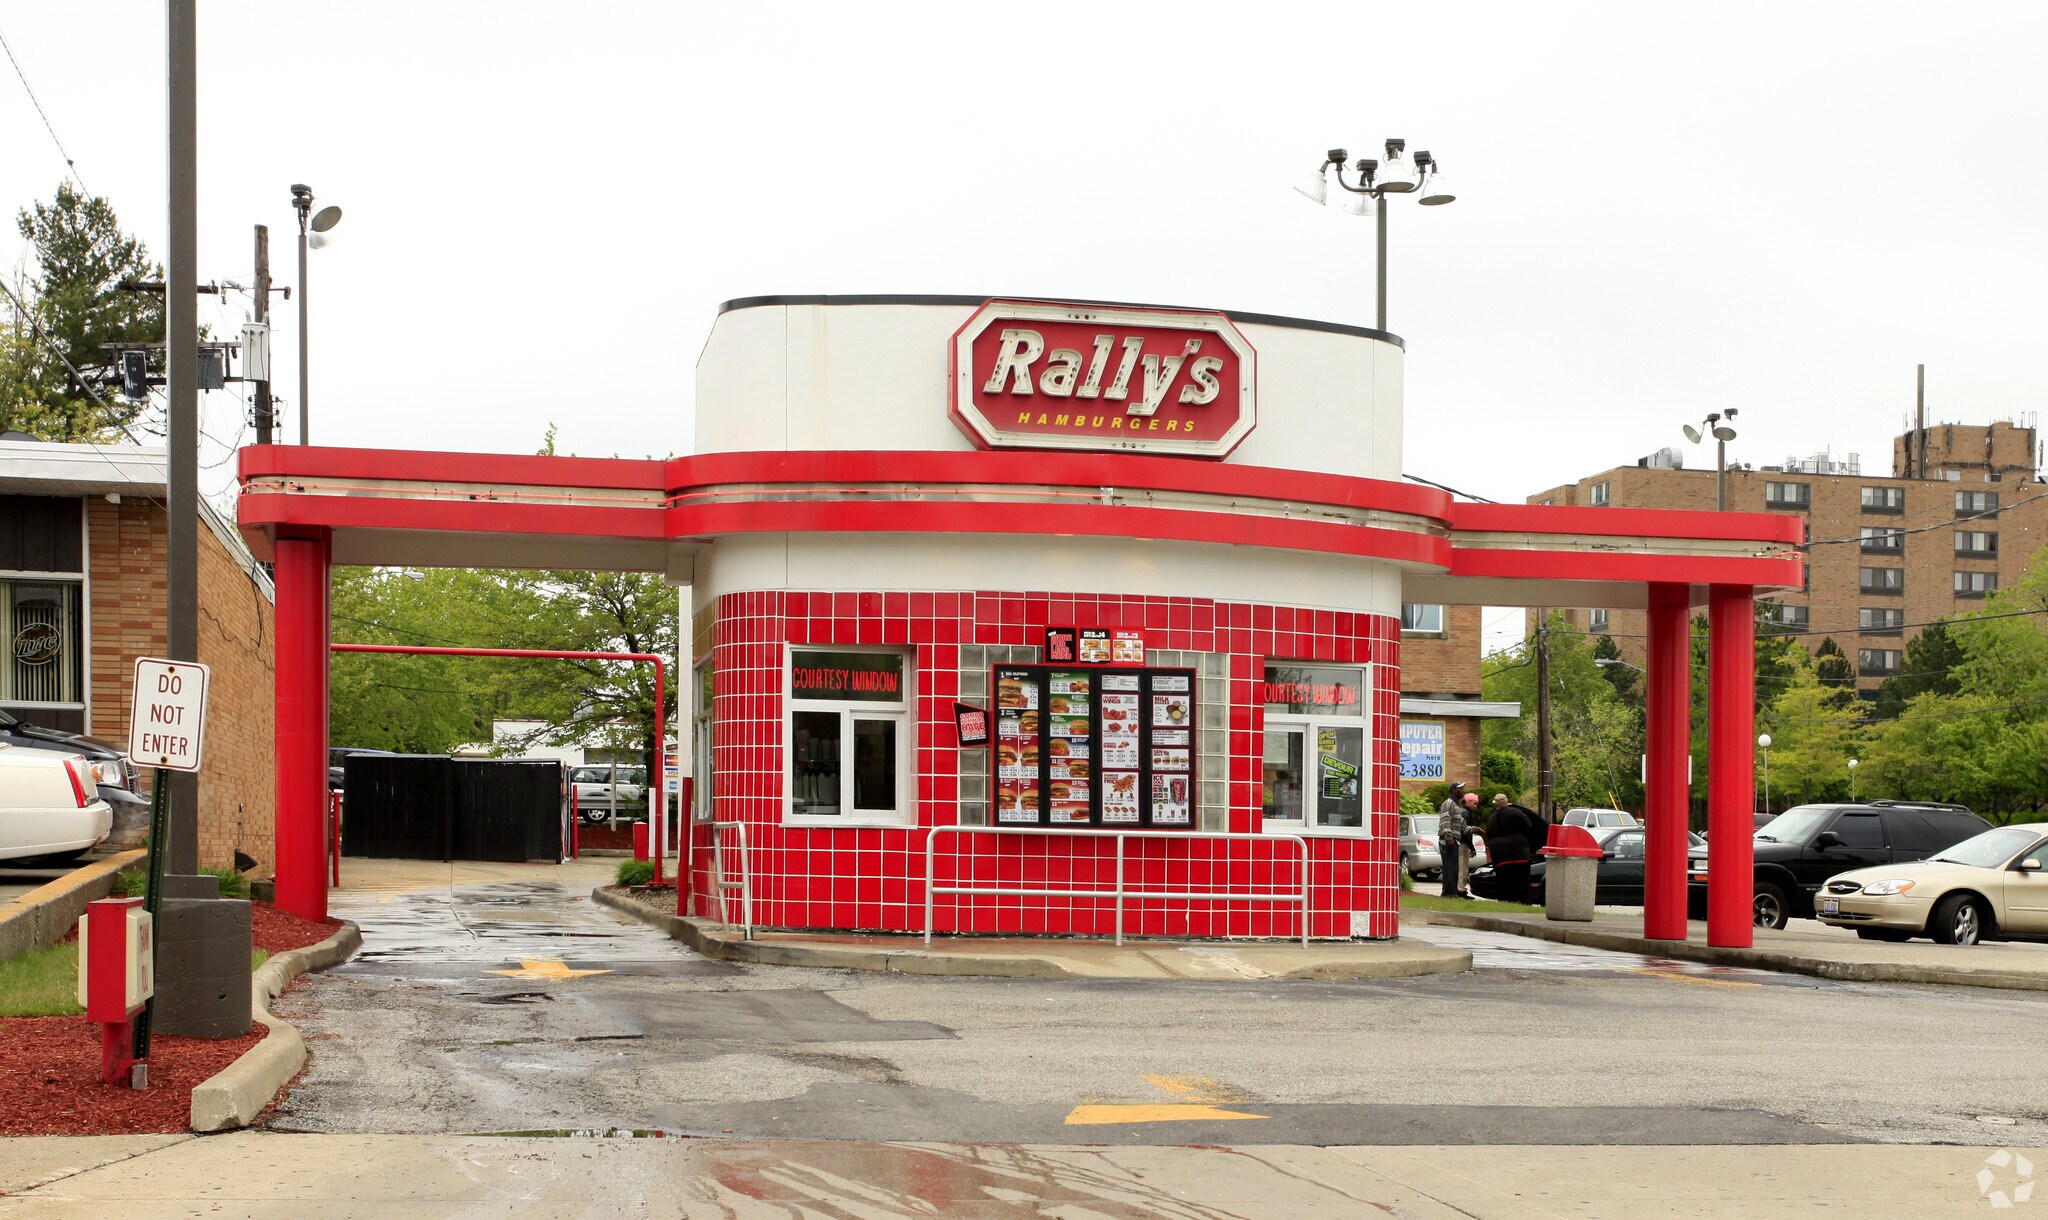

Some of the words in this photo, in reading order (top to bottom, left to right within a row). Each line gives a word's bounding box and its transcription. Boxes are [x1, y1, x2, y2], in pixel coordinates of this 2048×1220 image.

[983, 328, 1224, 416] Rally's
[1017, 412, 1195, 432] HAMBURGERS
[158, 674, 182, 695] DO
[792, 667, 849, 690] COURTESY
[851, 670, 898, 692] WINDOW
[1264, 682, 1310, 703] OURTESY
[1312, 684, 1356, 704] WINDOW
[150, 703, 185, 725] NOT
[962, 722, 985, 731] HAVE
[1400, 724, 1443, 739] MPUTER
[142, 733, 188, 756] ENTER
[1399, 739, 1443, 758] epair
[1323, 756, 1354, 775] DEVOUR
[1399, 763, 1443, 777] 2-3880
